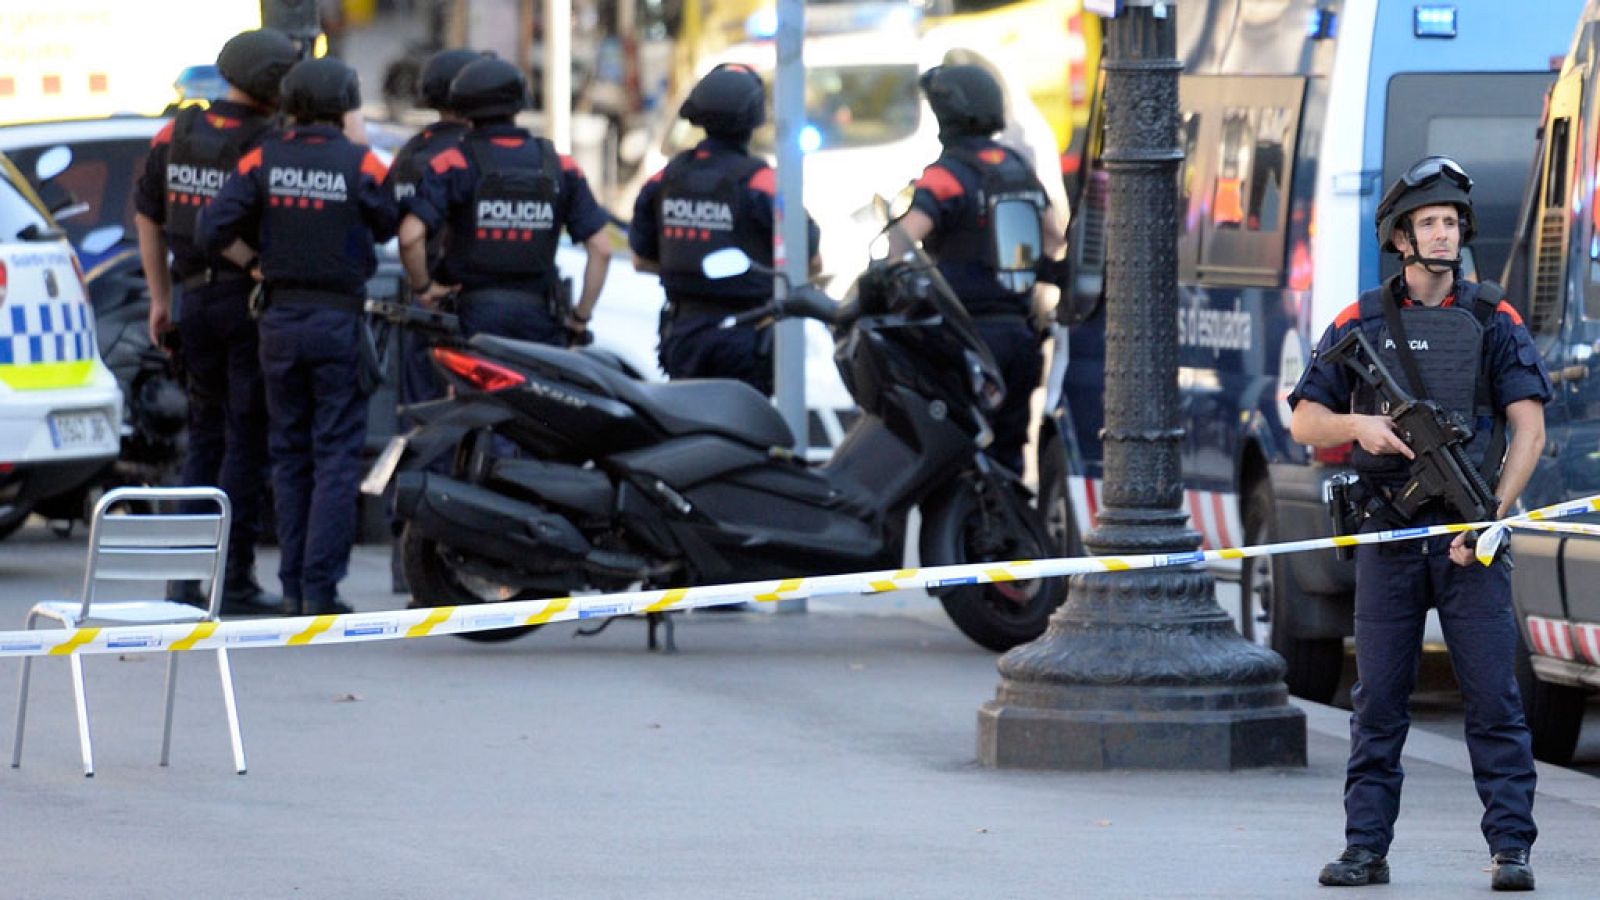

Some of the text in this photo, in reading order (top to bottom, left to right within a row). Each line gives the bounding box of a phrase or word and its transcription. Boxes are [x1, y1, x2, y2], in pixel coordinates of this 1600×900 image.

[167, 164, 230, 187] POLICI
[269, 167, 347, 192] POLICIA
[477, 200, 554, 221] POLICIA
[662, 199, 733, 220] POLICIA
[1385, 338, 1429, 351] PCIA
